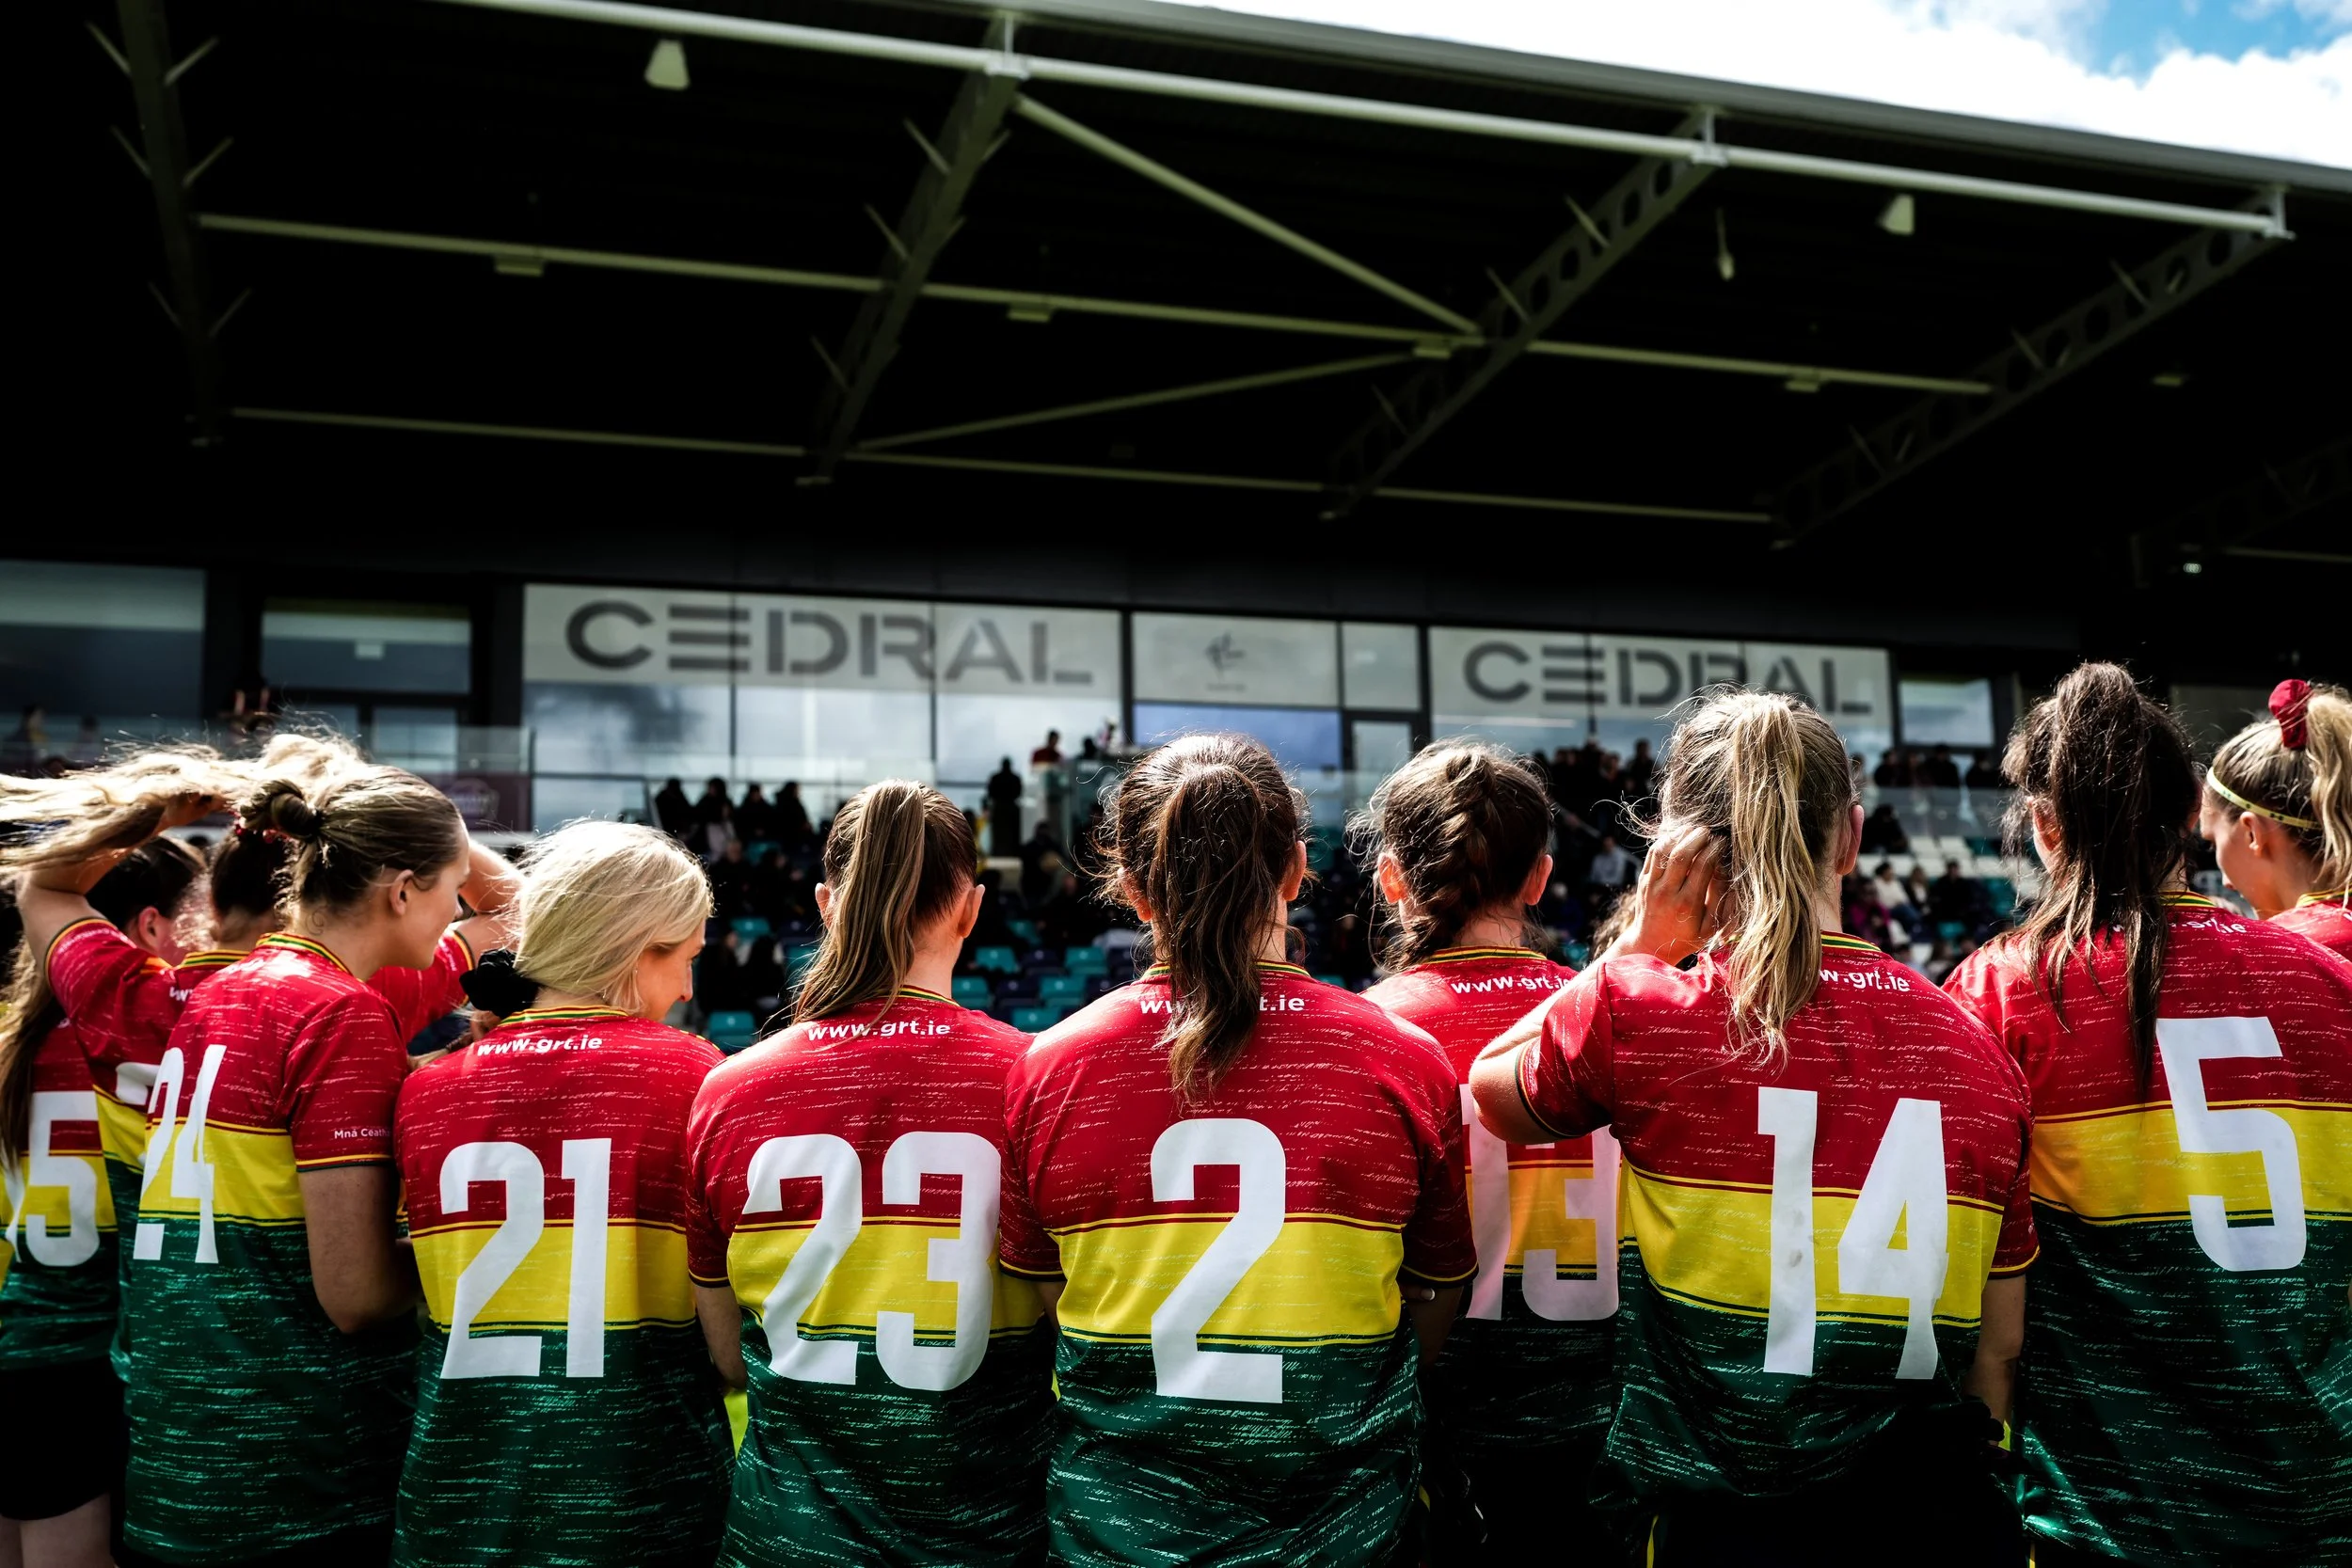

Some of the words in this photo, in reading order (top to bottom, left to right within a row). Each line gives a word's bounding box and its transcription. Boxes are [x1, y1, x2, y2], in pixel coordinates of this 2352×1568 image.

[564, 600, 1092, 686] CEDRAL
[1464, 641, 1871, 714] CEDRAL
[477, 1034, 603, 1056] www.grt.ie
[806, 1020, 951, 1041] www.grt.ie
[1140, 994, 1305, 1014] wwt.ie
[1820, 969, 1911, 992] w.grt.ie
[133, 1044, 227, 1264] 24
[2156, 1017, 2307, 1272] 5
[439, 1137, 612, 1379] 21
[741, 1132, 1002, 1391] 23
[1151, 1118, 1286, 1404] 2
[1757, 1086, 1948, 1380] 14
